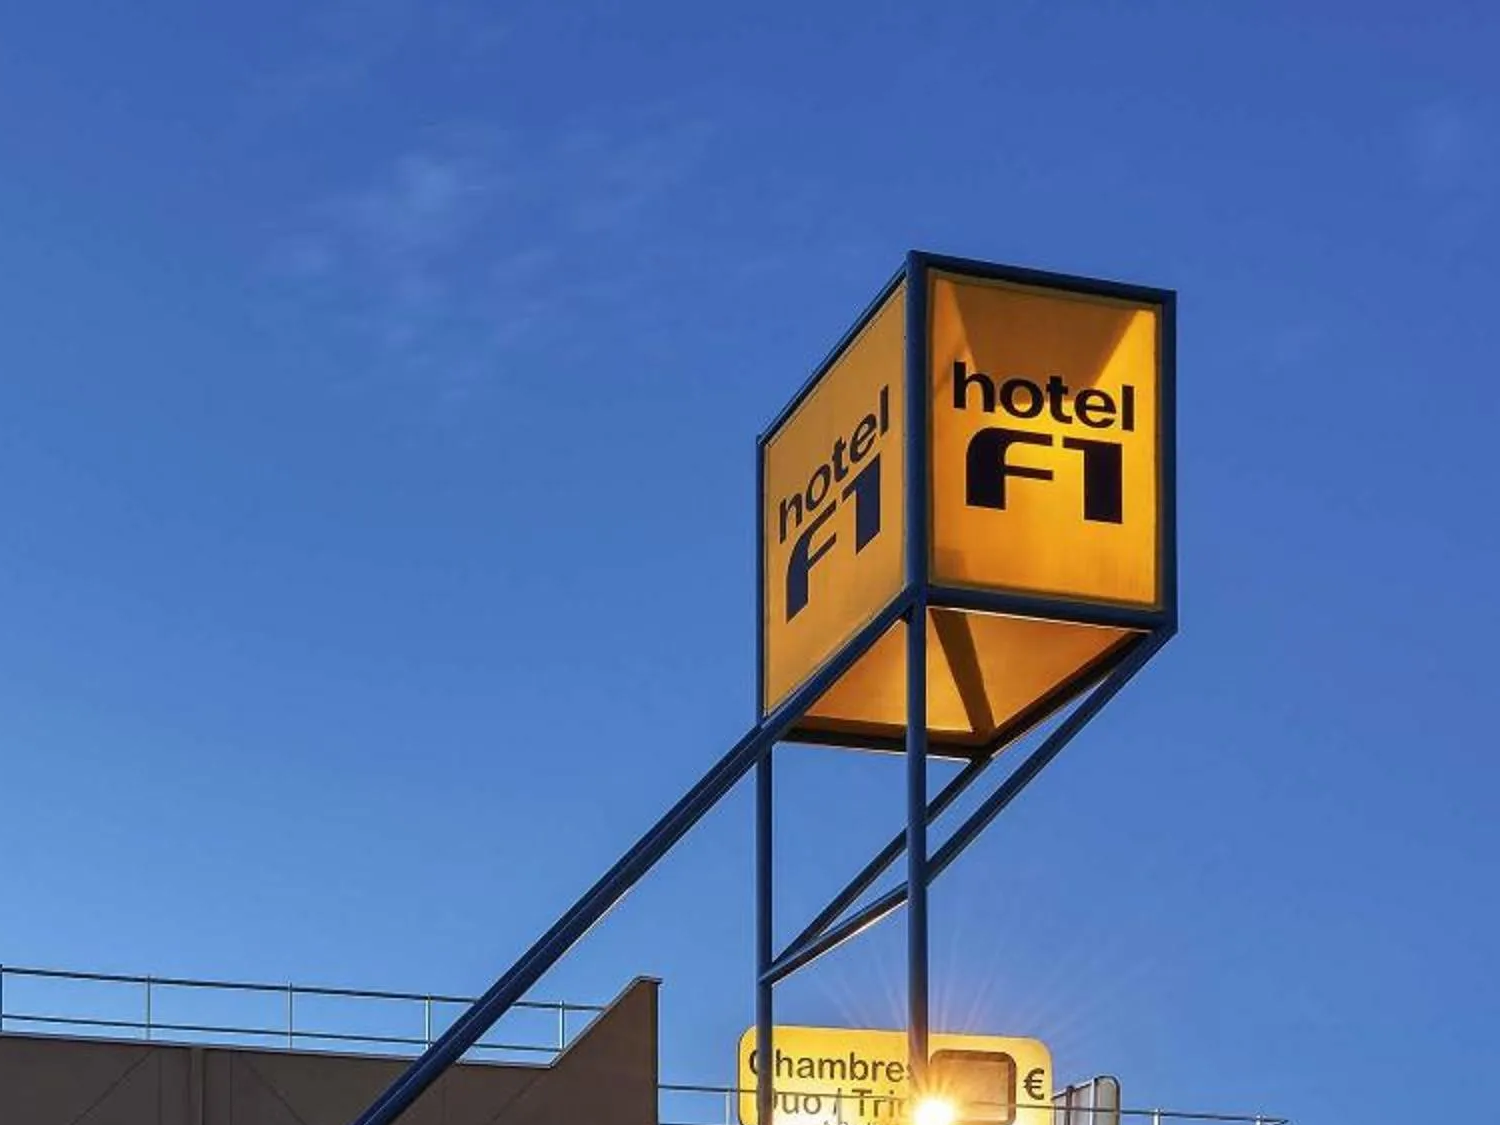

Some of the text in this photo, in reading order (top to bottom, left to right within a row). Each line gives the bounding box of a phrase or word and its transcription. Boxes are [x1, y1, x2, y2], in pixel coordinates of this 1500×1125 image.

[953, 360, 1135, 432] hotel
[779, 384, 889, 545] hotel
[965, 426, 1123, 524] F1
[786, 452, 881, 624] F1
[757, 1087, 822, 1115] uo
[1023, 1068, 1045, 1100] €
